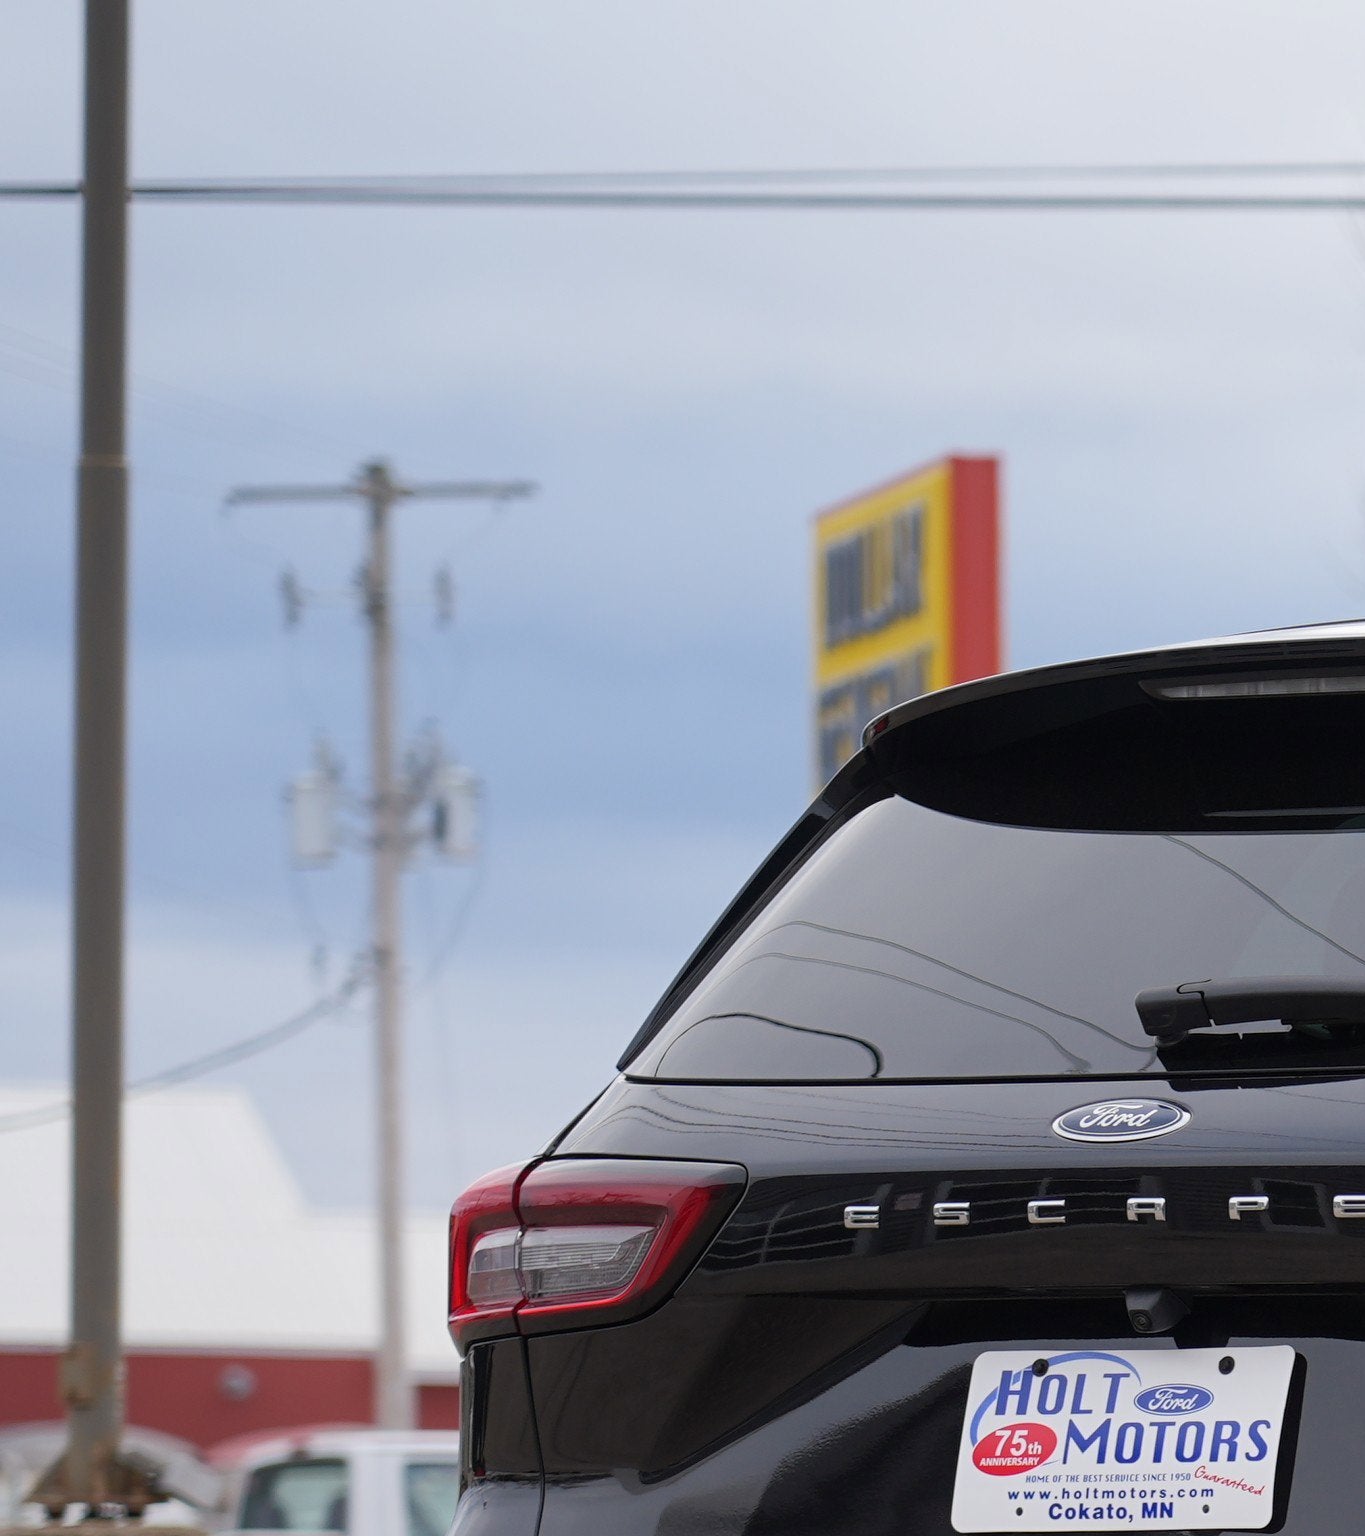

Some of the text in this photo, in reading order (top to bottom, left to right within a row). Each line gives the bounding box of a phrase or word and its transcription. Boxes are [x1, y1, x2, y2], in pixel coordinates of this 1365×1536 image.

[1079, 1103, 1158, 1128] Ford
[994, 1369, 1131, 1416] HOLT
[1148, 1386, 1200, 1411] Ford
[994, 1429, 1042, 1457] 75th
[1062, 1417, 1271, 1465] MOTORS
[979, 1456, 1040, 1467] ANNIVERSARY
[1025, 1472, 1191, 1484] HOME OF THE BEST SERVICE SINCE 1950
[1194, 1465, 1266, 1496] Guaranteed
[1007, 1487, 1215, 1500] www.holtmotors.com
[1048, 1502, 1174, 1523] Cokato, MN
